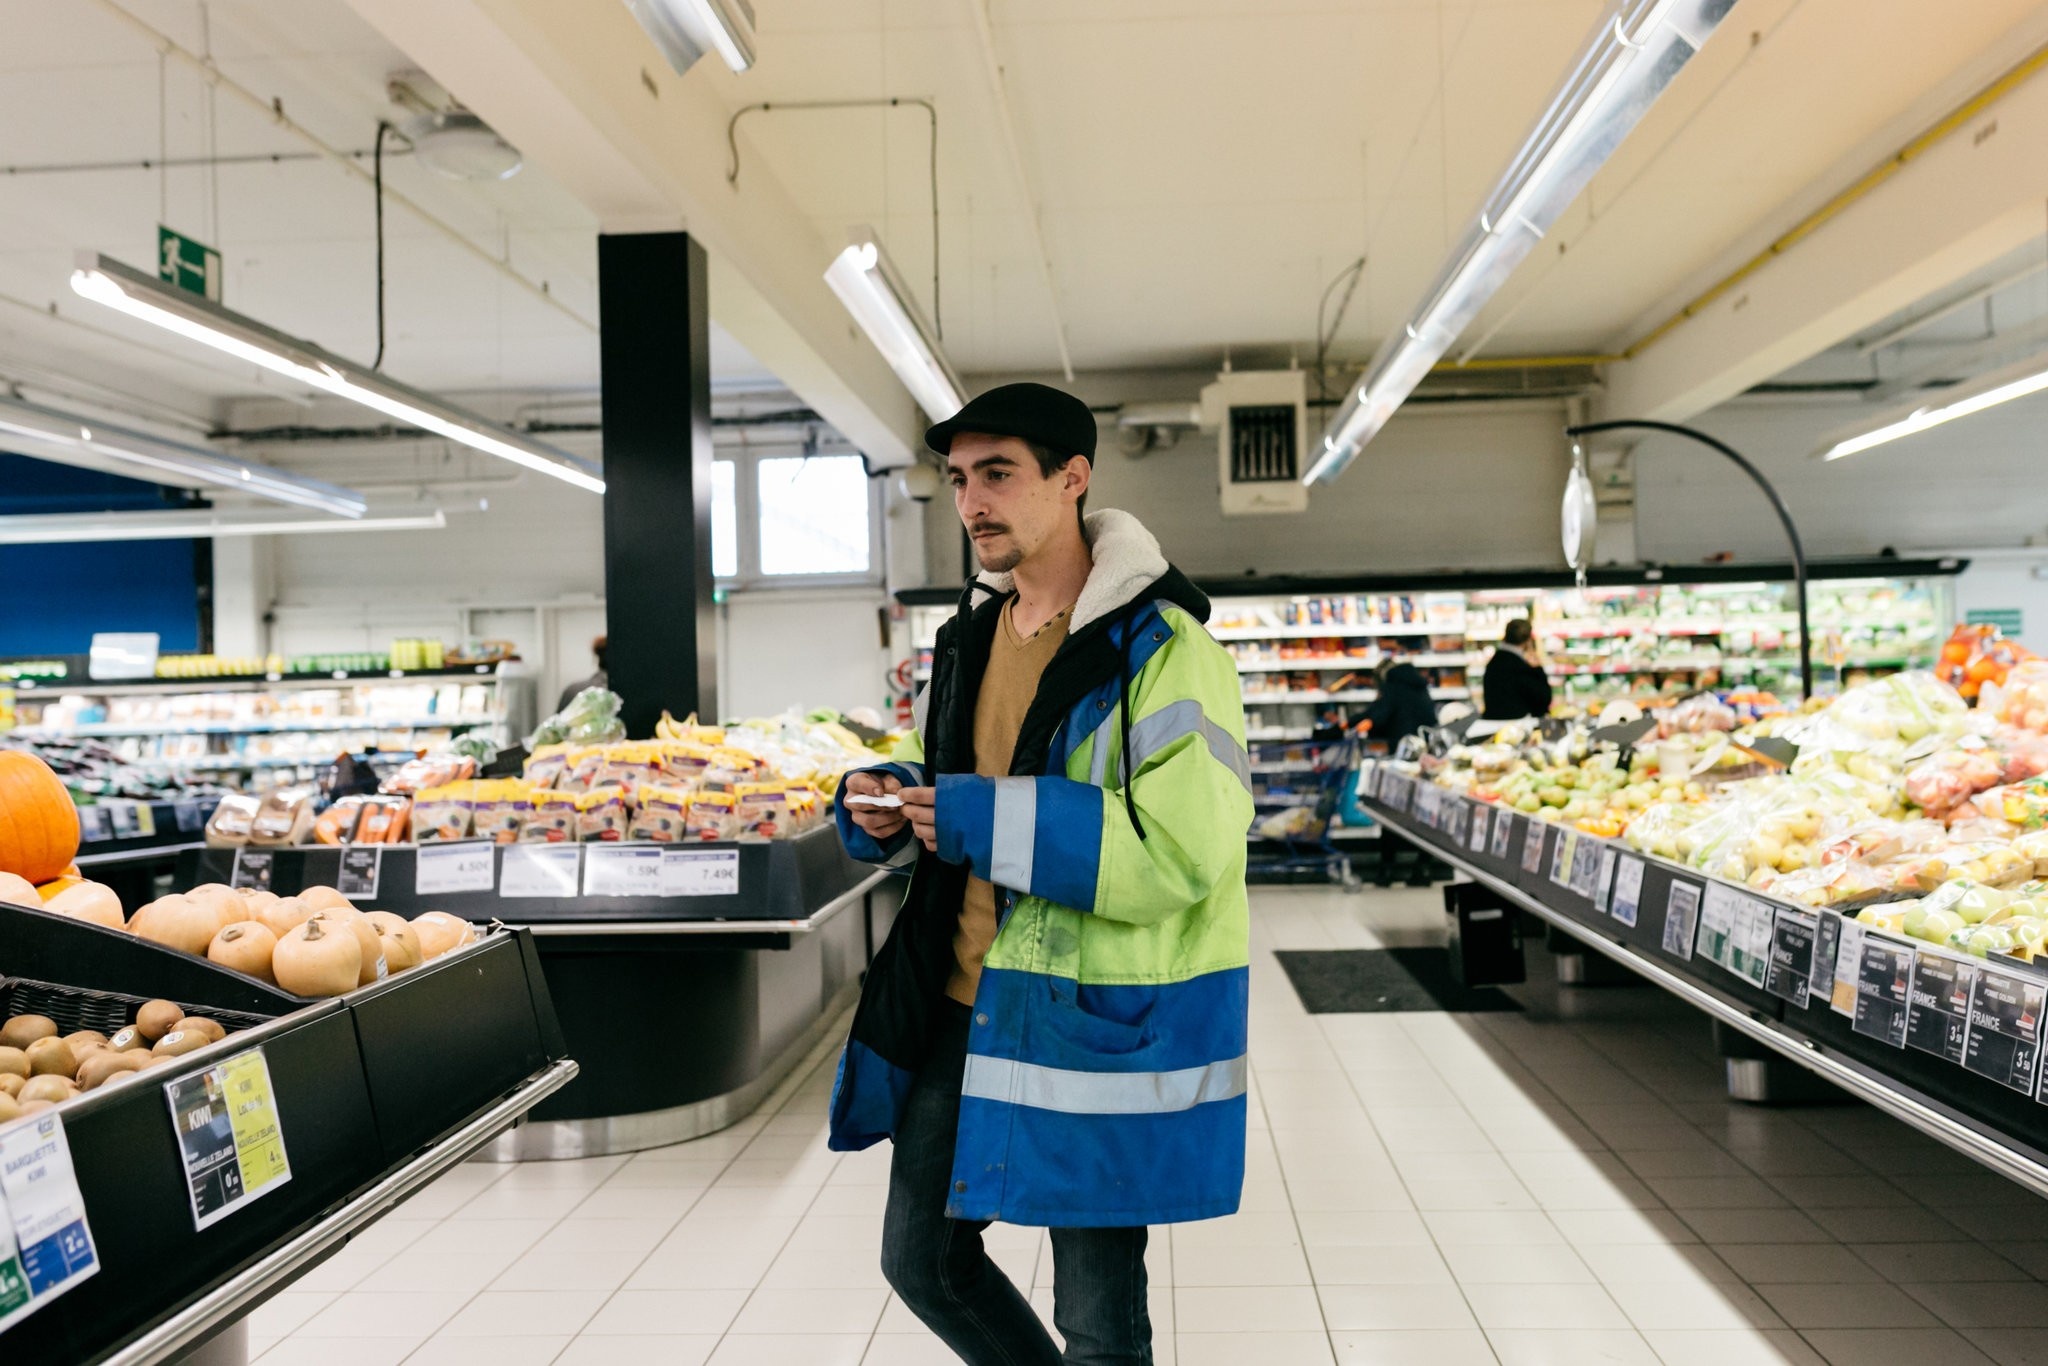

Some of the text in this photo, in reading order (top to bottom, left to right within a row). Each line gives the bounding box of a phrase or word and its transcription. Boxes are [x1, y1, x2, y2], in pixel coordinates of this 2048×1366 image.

[702, 868, 734, 880] 7.49€
[1859, 980, 1880, 997] FRANCE
[1912, 990, 1937, 1008] FRANCE
[1972, 1010, 2000, 1031] FRANCE
[188, 1104, 212, 1132] KIWI
[5, 1142, 57, 1175] BARQUETTE
